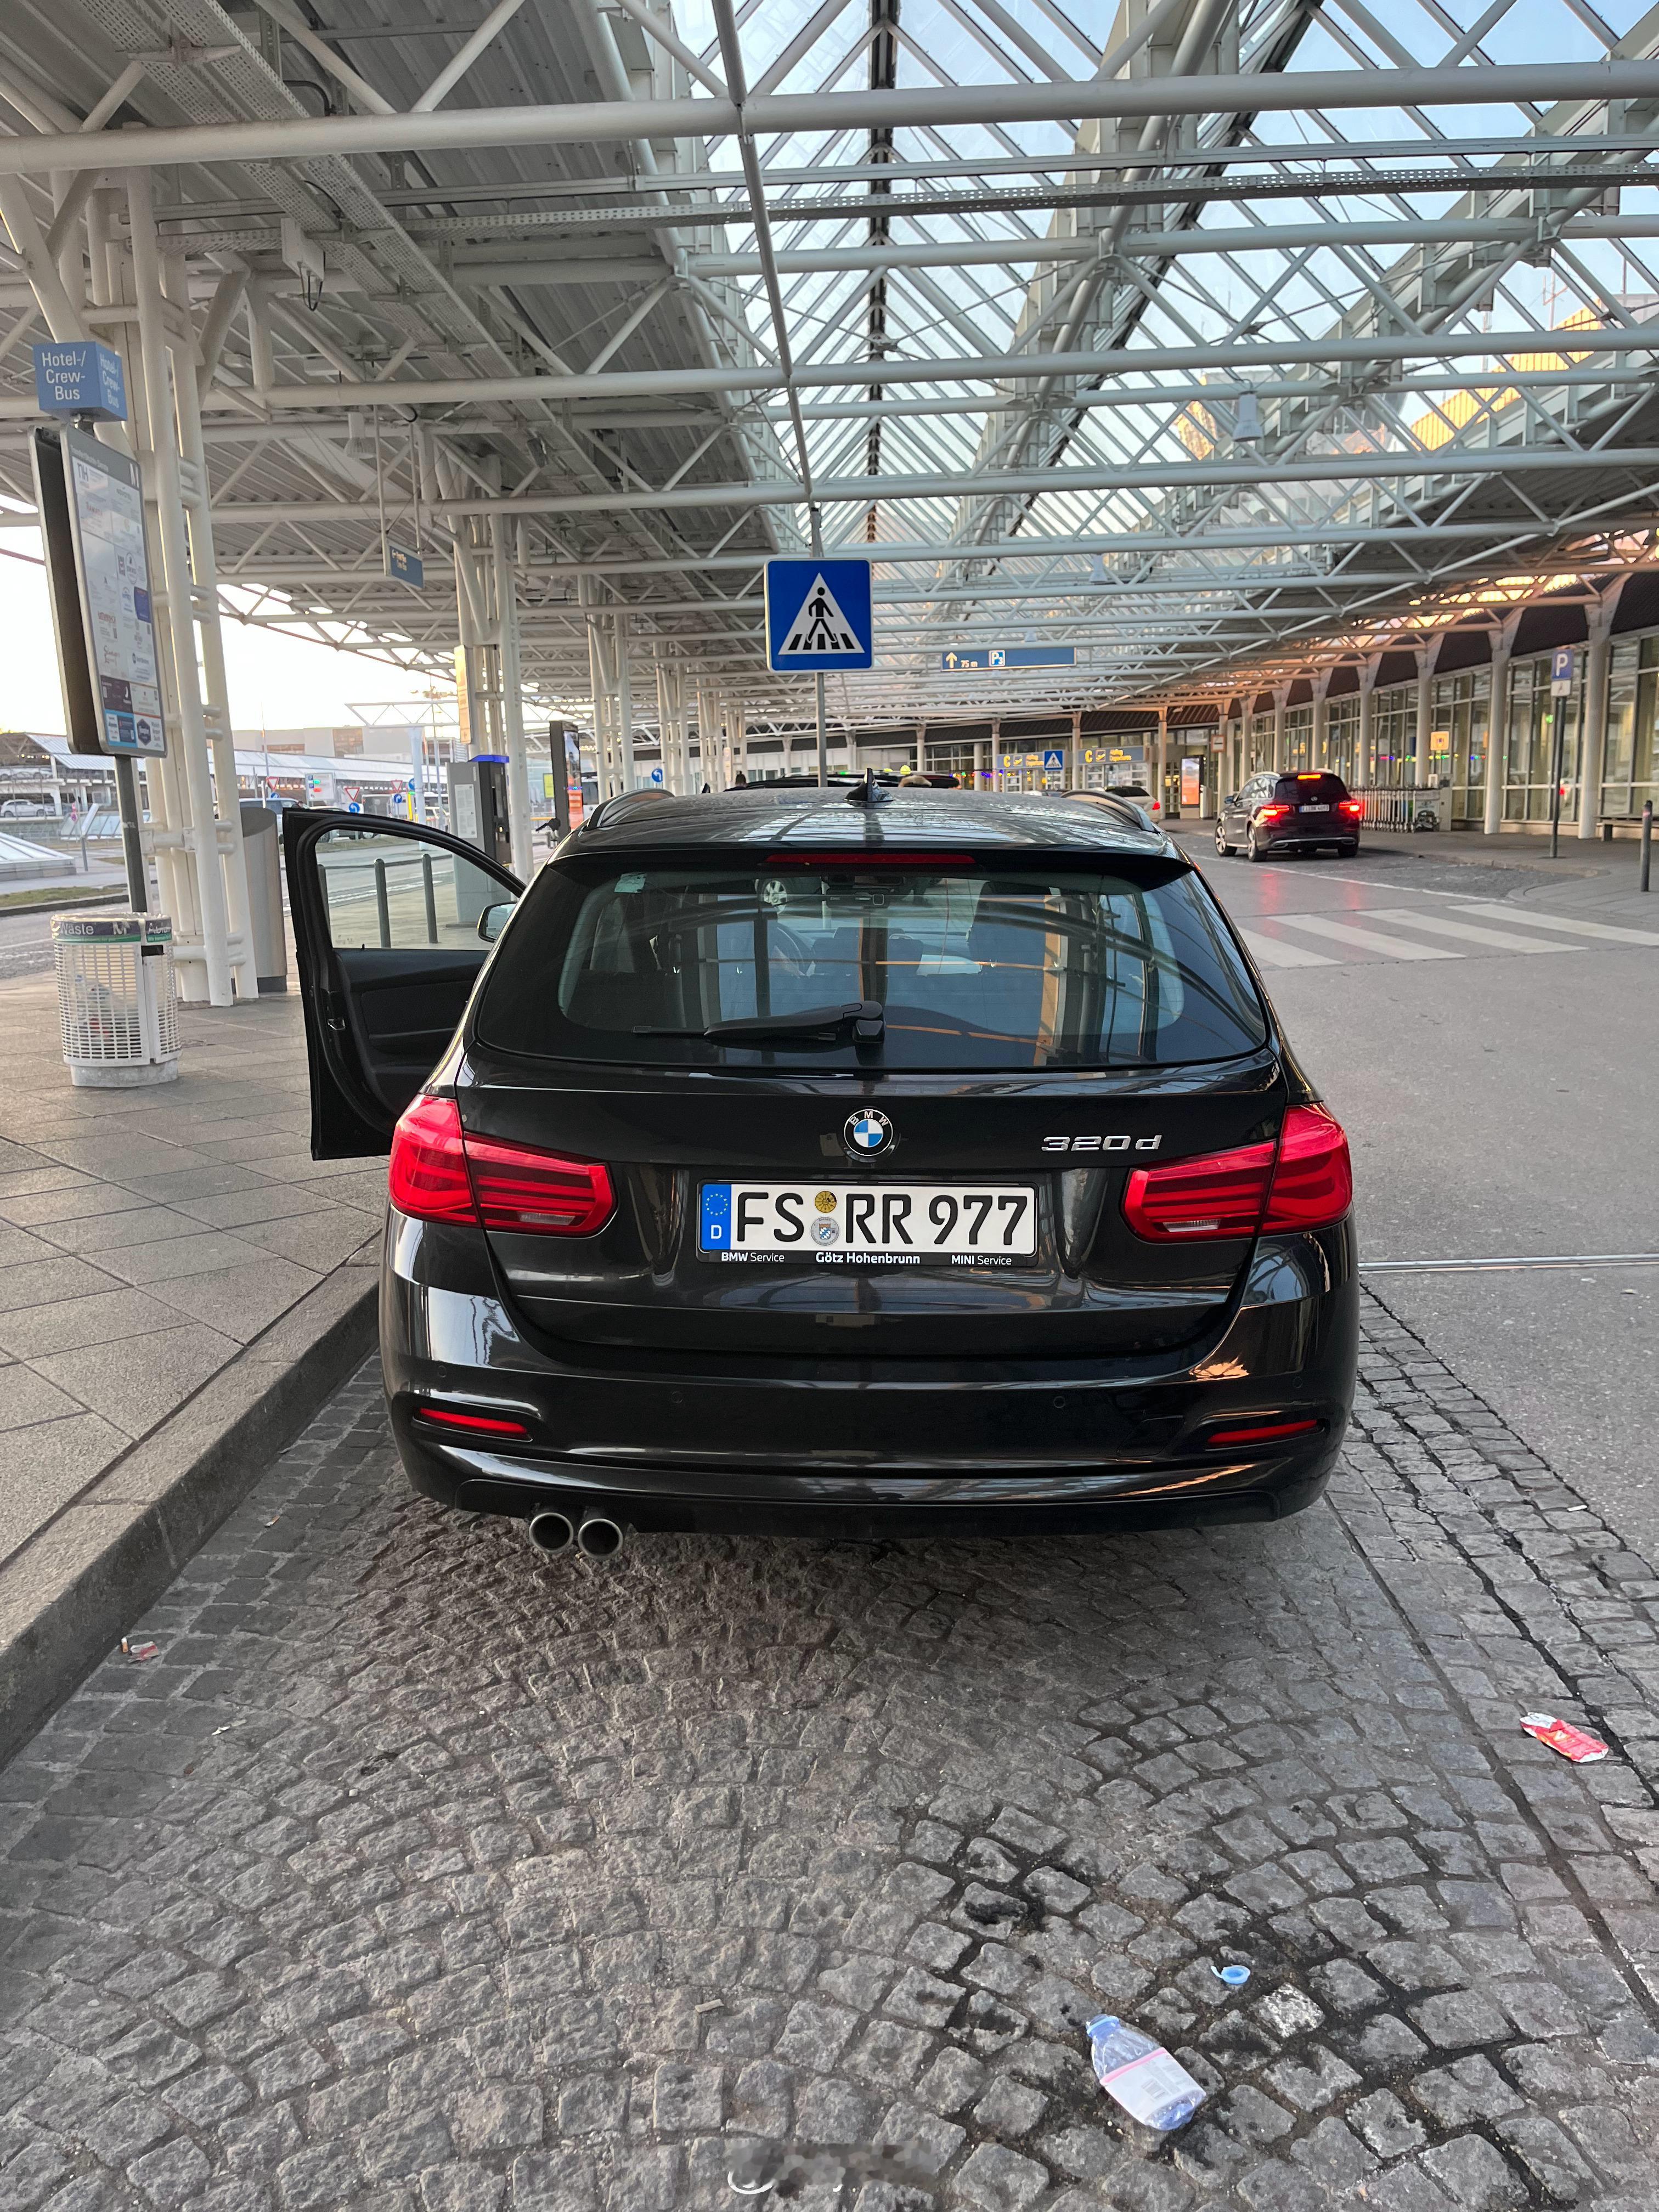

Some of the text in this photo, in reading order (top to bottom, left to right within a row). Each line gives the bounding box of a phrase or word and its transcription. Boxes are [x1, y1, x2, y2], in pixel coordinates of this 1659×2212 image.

[42, 351, 87, 367] Hotel-/
[46, 369, 86, 384] Crew-
[54, 385, 81, 400] Bus
[960, 660, 970, 668] 75
[1556, 653, 1568, 676] P
[1003, 755, 1011, 768] C
[1085, 750, 1093, 764] C
[60, 922, 94, 935] Waste
[849, 1111, 889, 1126] BMW
[737, 1192, 804, 1242] FS
[845, 1193, 913, 1244] RR
[929, 1194, 1028, 1245] 977
[710, 1224, 723, 1239] D
[721, 1251, 785, 1262] BMW Service
[815, 1251, 921, 1265] Götz Hohenbrunn
[951, 1254, 1012, 1265] MINI Service
